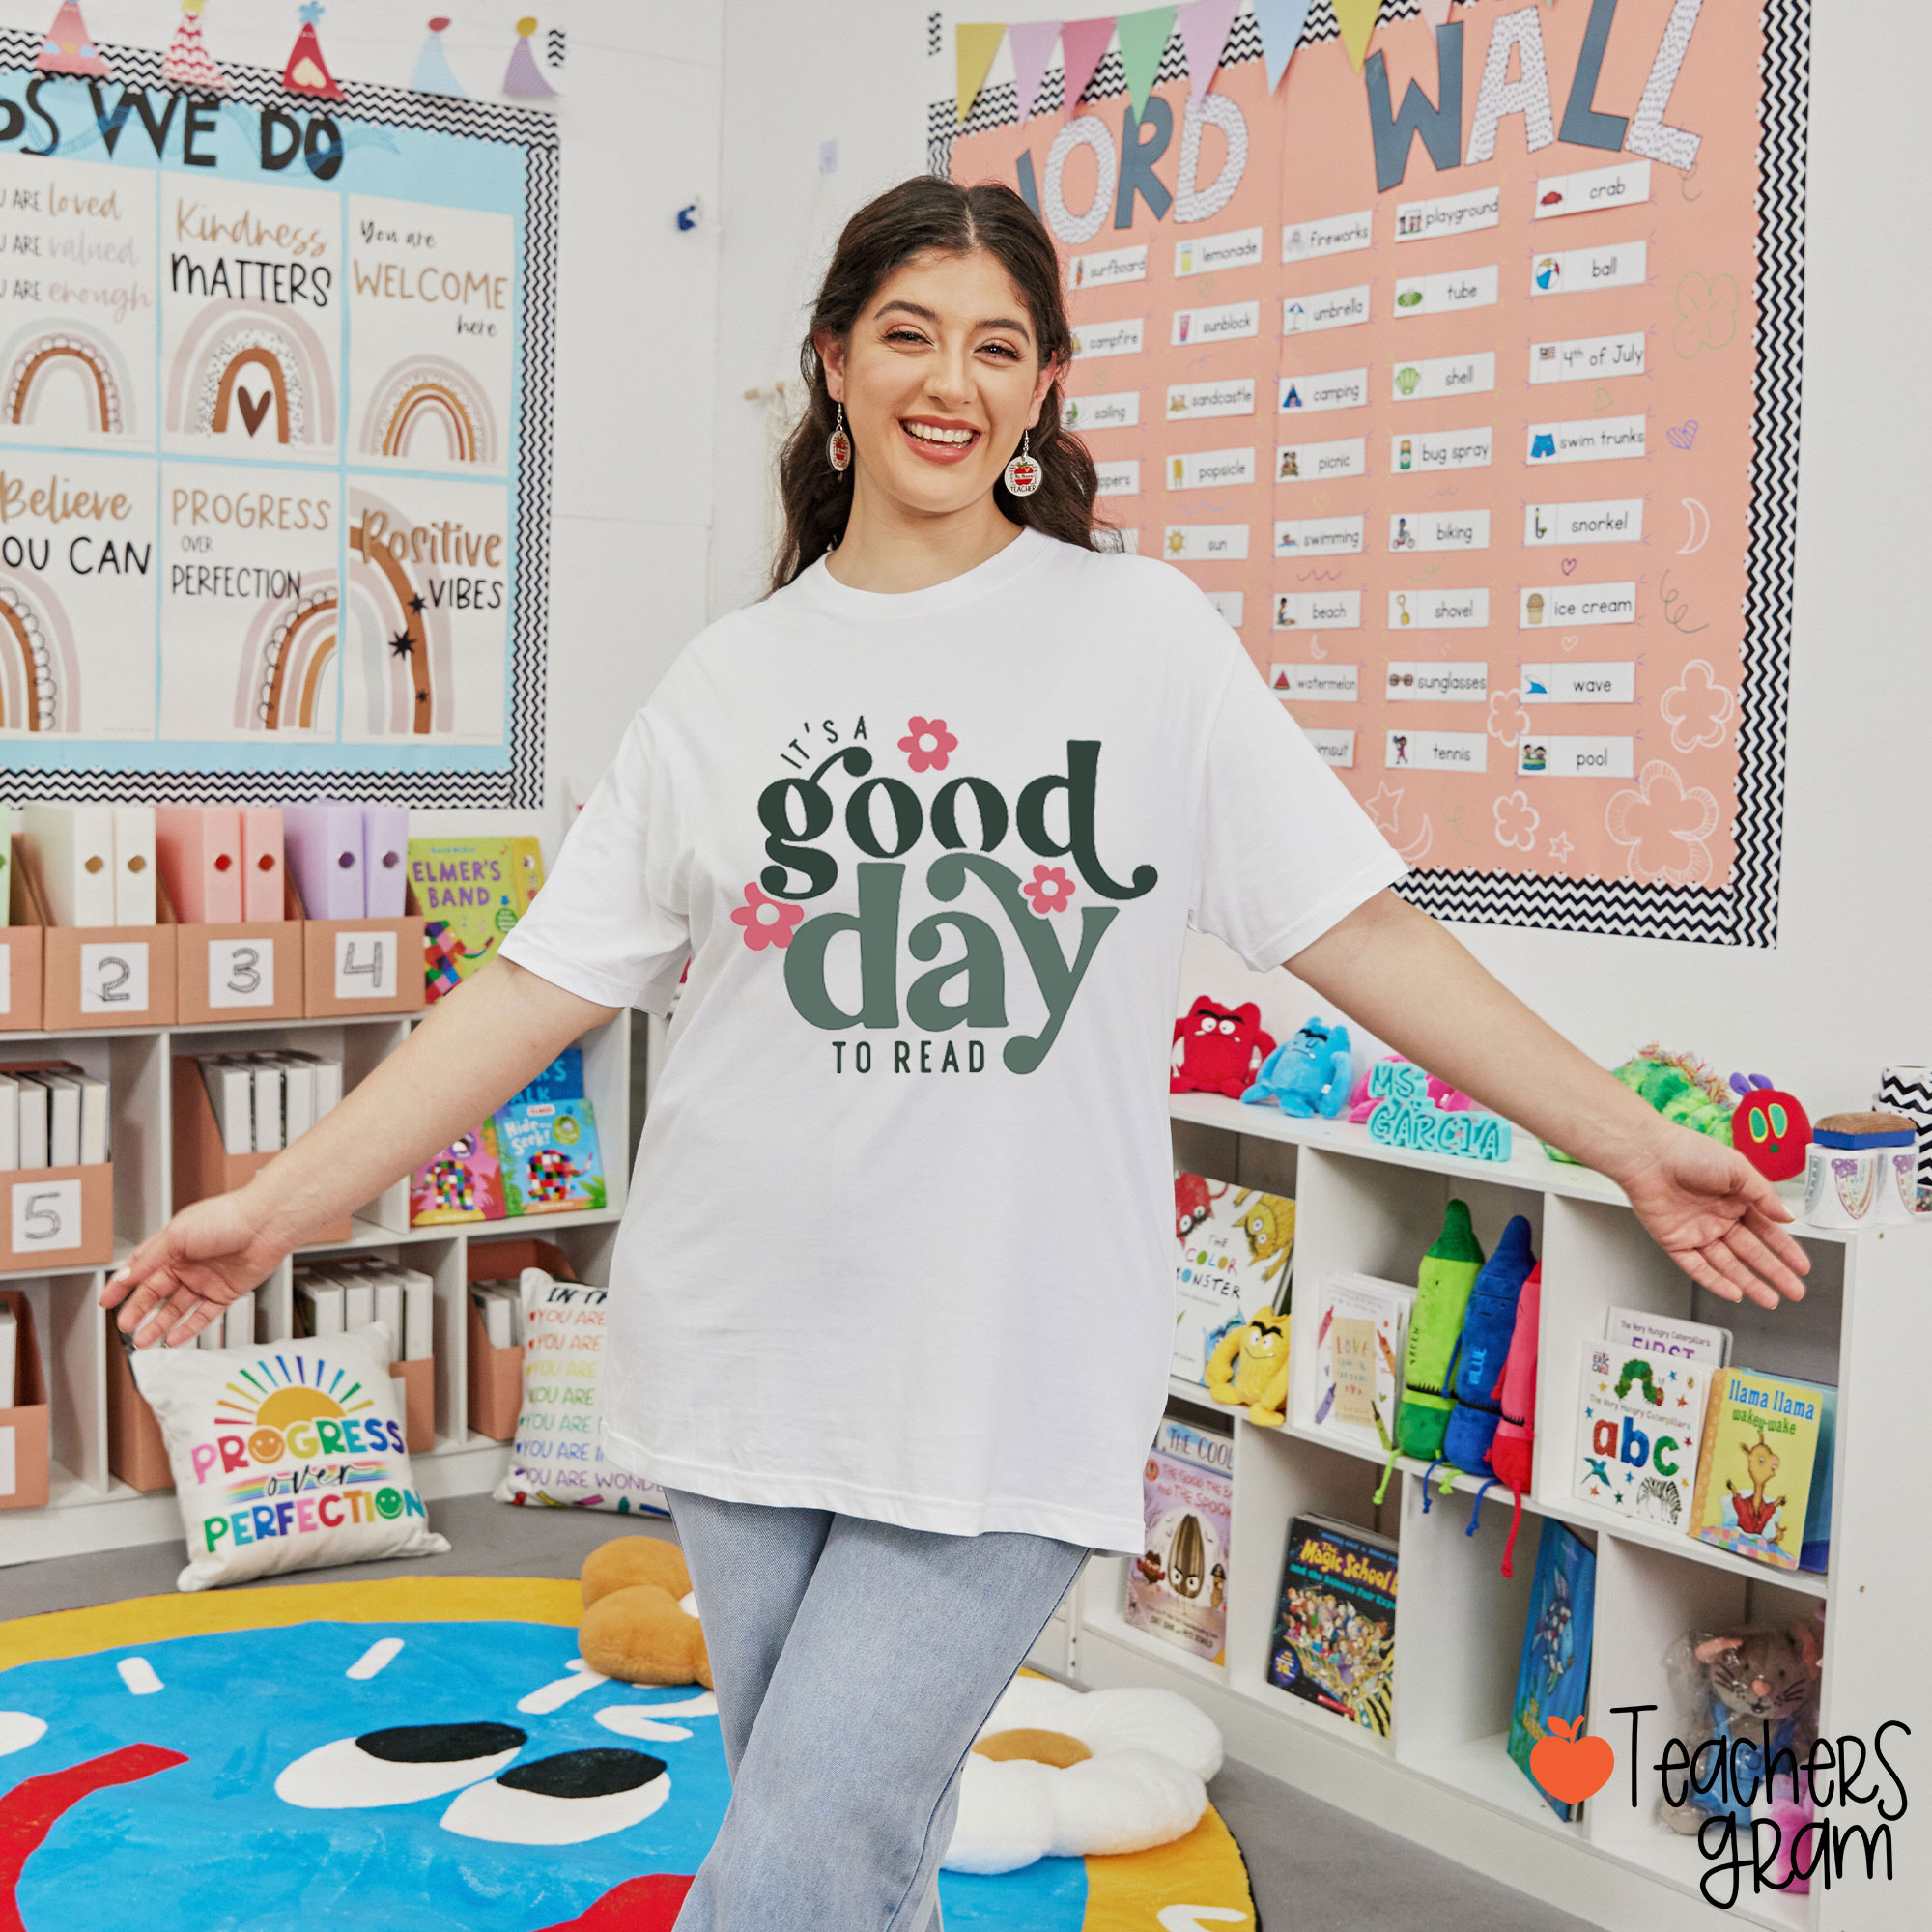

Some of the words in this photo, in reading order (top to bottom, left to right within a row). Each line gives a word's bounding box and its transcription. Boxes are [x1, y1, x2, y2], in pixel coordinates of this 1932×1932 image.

[87, 80, 219, 168] WE
[259, 107, 345, 181] DO
[1016, 91, 1249, 245] ORD
[1364, 0, 1703, 194] WALL
[13, 188, 42, 212] ARE
[49, 181, 122, 221] loved
[1589, 180, 1626, 200] crab
[1425, 194, 1499, 228] playground
[176, 197, 327, 258] Kindness
[360, 220, 399, 244] You
[406, 230, 437, 248] are
[1309, 227, 1369, 249] fireworks
[13, 234, 42, 257] ARE
[49, 228, 138, 267] valued
[1202, 241, 1258, 263] lemonade
[1090, 255, 1147, 279] surfboard
[1591, 256, 1618, 279] ball
[171, 252, 332, 308] MATTERS
[353, 258, 509, 311] WELCOME
[1447, 282, 1478, 301] tube
[13, 279, 42, 302] ARE
[49, 281, 152, 325] enough
[1312, 298, 1364, 322] umbrella
[456, 314, 498, 337] here
[1202, 311, 1252, 335] sunblock
[1090, 329, 1138, 351] campfire
[1589, 346, 1607, 367] of
[1612, 344, 1644, 365] July
[1444, 365, 1474, 386] shell
[1192, 388, 1253, 408] sandcastle
[1313, 384, 1360, 406] camping
[1094, 405, 1127, 422] sailing
[1559, 434, 1595, 450] swim
[1600, 427, 1645, 446] trunks
[1318, 455, 1351, 473] picnic
[1422, 444, 1447, 465] bug
[1451, 440, 1489, 464] spray
[1098, 474, 1131, 490] ppers
[1198, 461, 1246, 482] popsicle
[0, 470, 133, 525] Believe
[1009, 484, 1037, 493] TEACHER
[171, 488, 331, 531] PROGRESS
[1571, 511, 1629, 532] snorkel
[181, 534, 213, 554] OVER
[361, 507, 502, 568] Positive
[1208, 538, 1228, 552] sun
[1303, 528, 1360, 550] swimming
[1436, 523, 1473, 545] biking
[2, 536, 50, 571] OU
[69, 536, 152, 575] CAN
[171, 564, 301, 599] PERFECTION
[428, 577, 504, 610] VIBES
[1312, 604, 1347, 620] beach
[1435, 600, 1474, 619] shovel
[1553, 601, 1576, 616] ice
[1581, 598, 1633, 615] cream
[1296, 675, 1356, 691] watermelon
[1417, 672, 1487, 694] sunglasses
[1573, 678, 1612, 693] wave
[780, 718, 839, 770] IT'S
[853, 715, 868, 741] A
[1315, 742, 1349, 757] imsuit
[1433, 744, 1472, 762] tennis
[1577, 748, 1608, 770] pool
[757, 739, 1159, 901] good
[412, 859, 502, 882] ELMER'S
[428, 886, 491, 909] BAND
[227, 947, 262, 995] 3
[343, 940, 384, 989] 4
[783, 852, 1121, 1076] day
[98, 955, 131, 1003] 2
[832, 1039, 871, 1074] TO
[895, 1039, 986, 1074] READ
[510, 1086, 551, 1104] ALK
[504, 1117, 538, 1139] Hide
[1369, 1101, 1507, 1159] GARCIA
[511, 1129, 551, 1156] Seek!
[24, 1190, 63, 1240] 5
[1208, 1234, 1229, 1248] THE
[1185, 1247, 1238, 1275] COLOR
[538, 1309, 573, 1324] YOU
[574, 1310, 608, 1327] ARE
[536, 1333, 566, 1350] YOU
[569, 1334, 604, 1351] ARE
[1621, 1319, 1632, 1329] The
[1633, 1322, 1646, 1334] Very
[1648, 1326, 1670, 1339] Hungry
[1671, 1330, 1711, 1347] Caterpillar's
[565, 1360, 599, 1378] ARE
[562, 1387, 596, 1406] ARE
[1728, 1378, 1769, 1409] llama
[1772, 1389, 1815, 1421] llama
[1620, 1404, 1645, 1419] Hungry
[1732, 1408, 1797, 1435] wakey-wake
[559, 1415, 593, 1434] ARE
[191, 1418, 406, 1485] PROGRESS
[522, 1440, 554, 1459] YOU
[556, 1442, 591, 1462] ARE
[1171, 1428, 1190, 1455] THE
[1593, 1416, 1680, 1477] abc
[264, 1463, 377, 1499] over
[555, 1470, 589, 1488] ARE
[203, 1486, 428, 1553] PERFECTION
[1321, 1541, 1338, 1553] The
[1299, 1538, 1344, 1573] Magic
[1342, 1553, 1393, 1591] School
